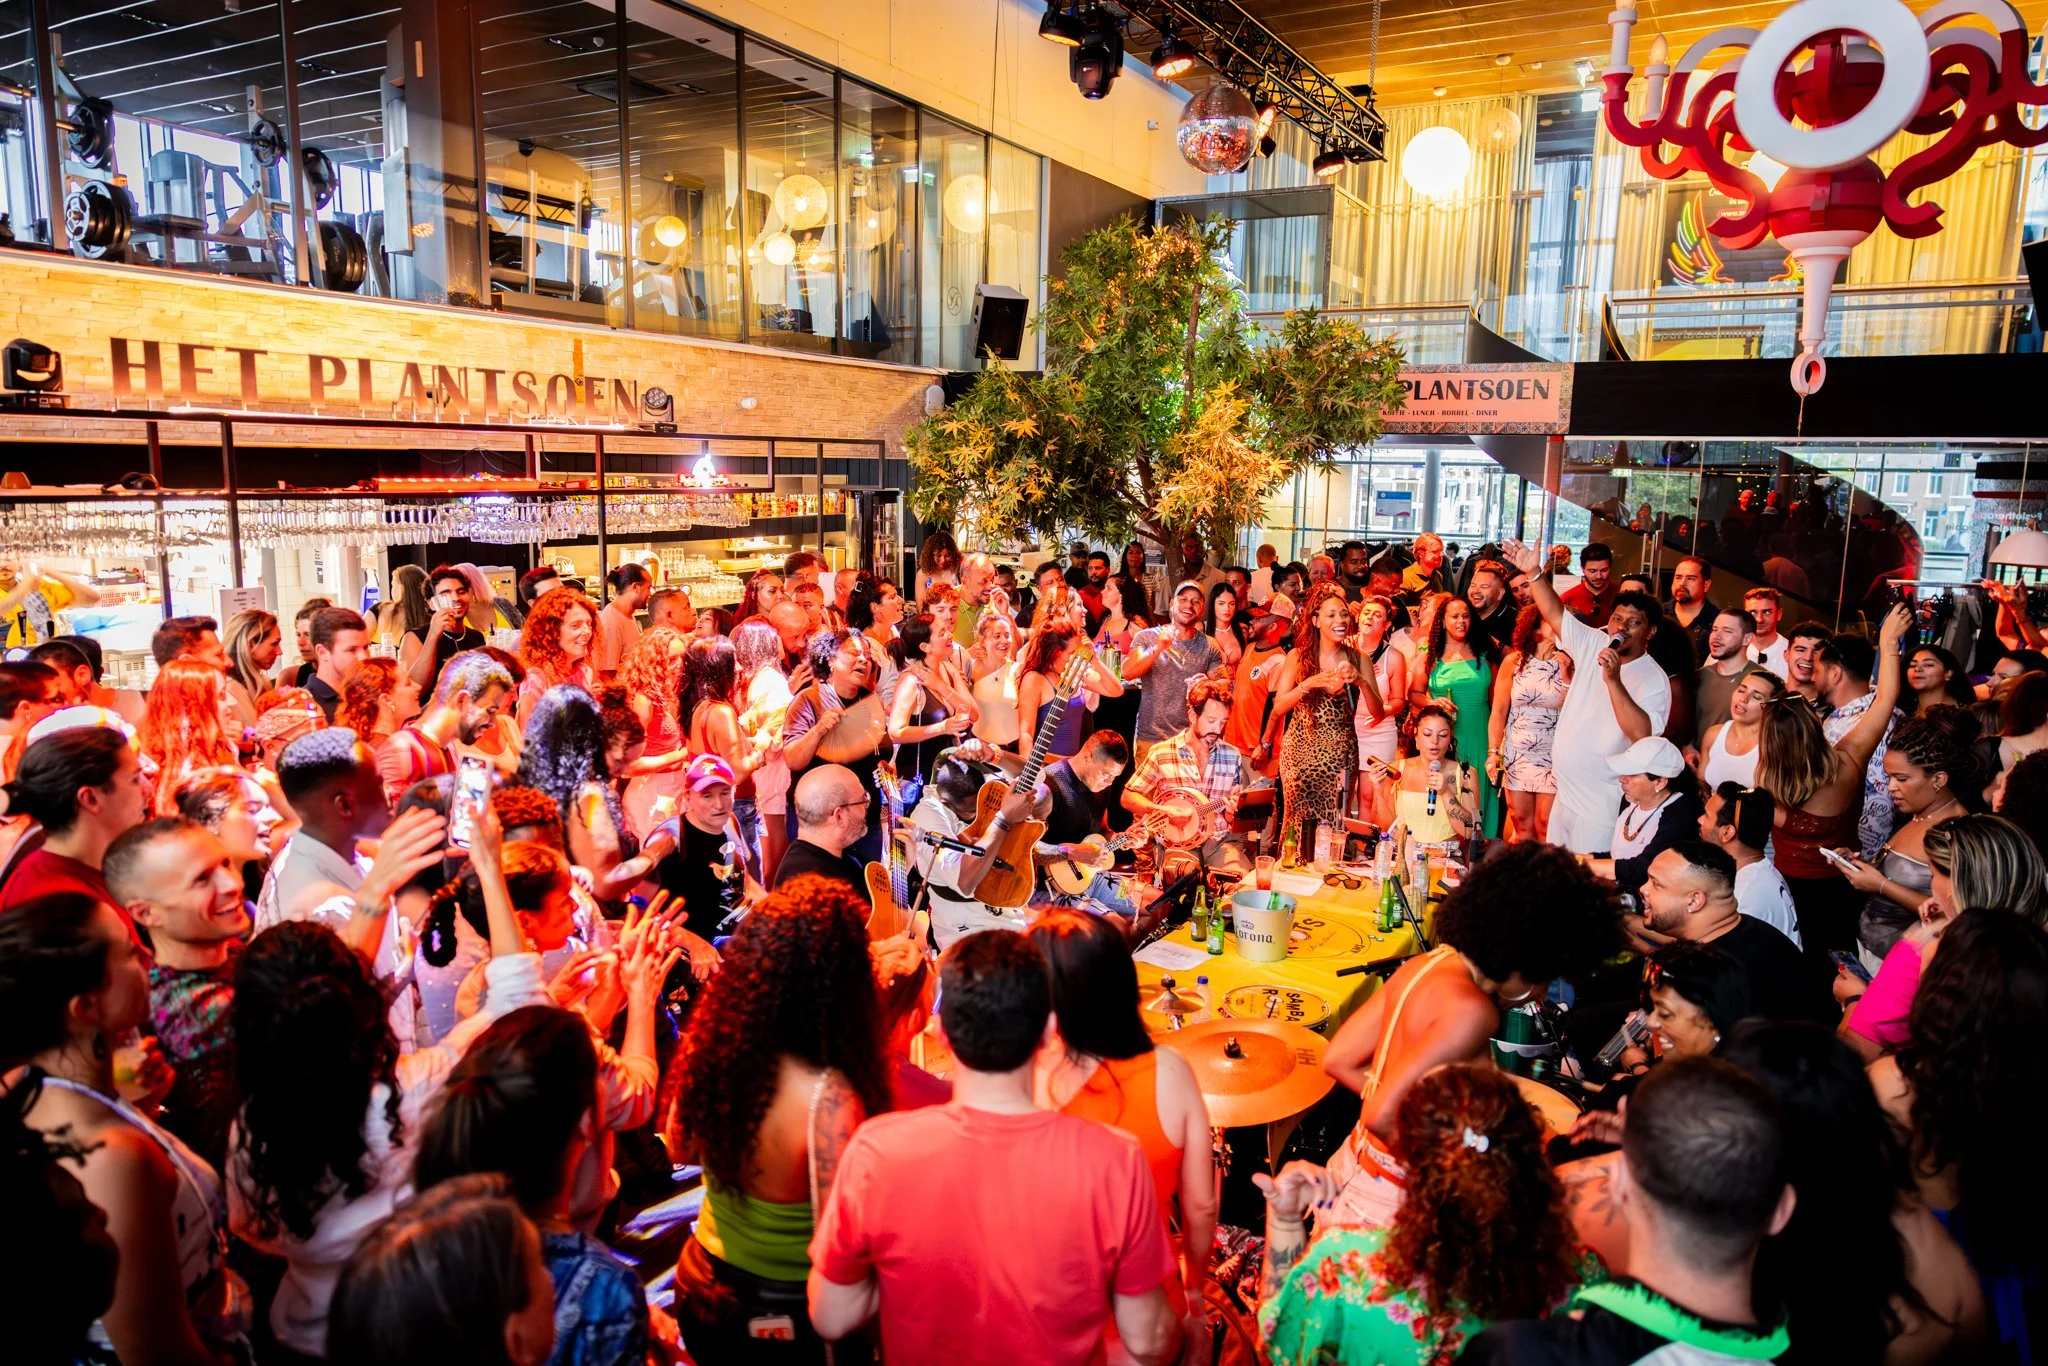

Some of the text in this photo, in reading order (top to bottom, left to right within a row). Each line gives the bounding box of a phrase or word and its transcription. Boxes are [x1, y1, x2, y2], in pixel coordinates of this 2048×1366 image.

[110, 337, 637, 426] HET PLANTSOEN
[1234, 925, 1273, 944] Corona
[1285, 992, 1305, 1022] SAMBA
